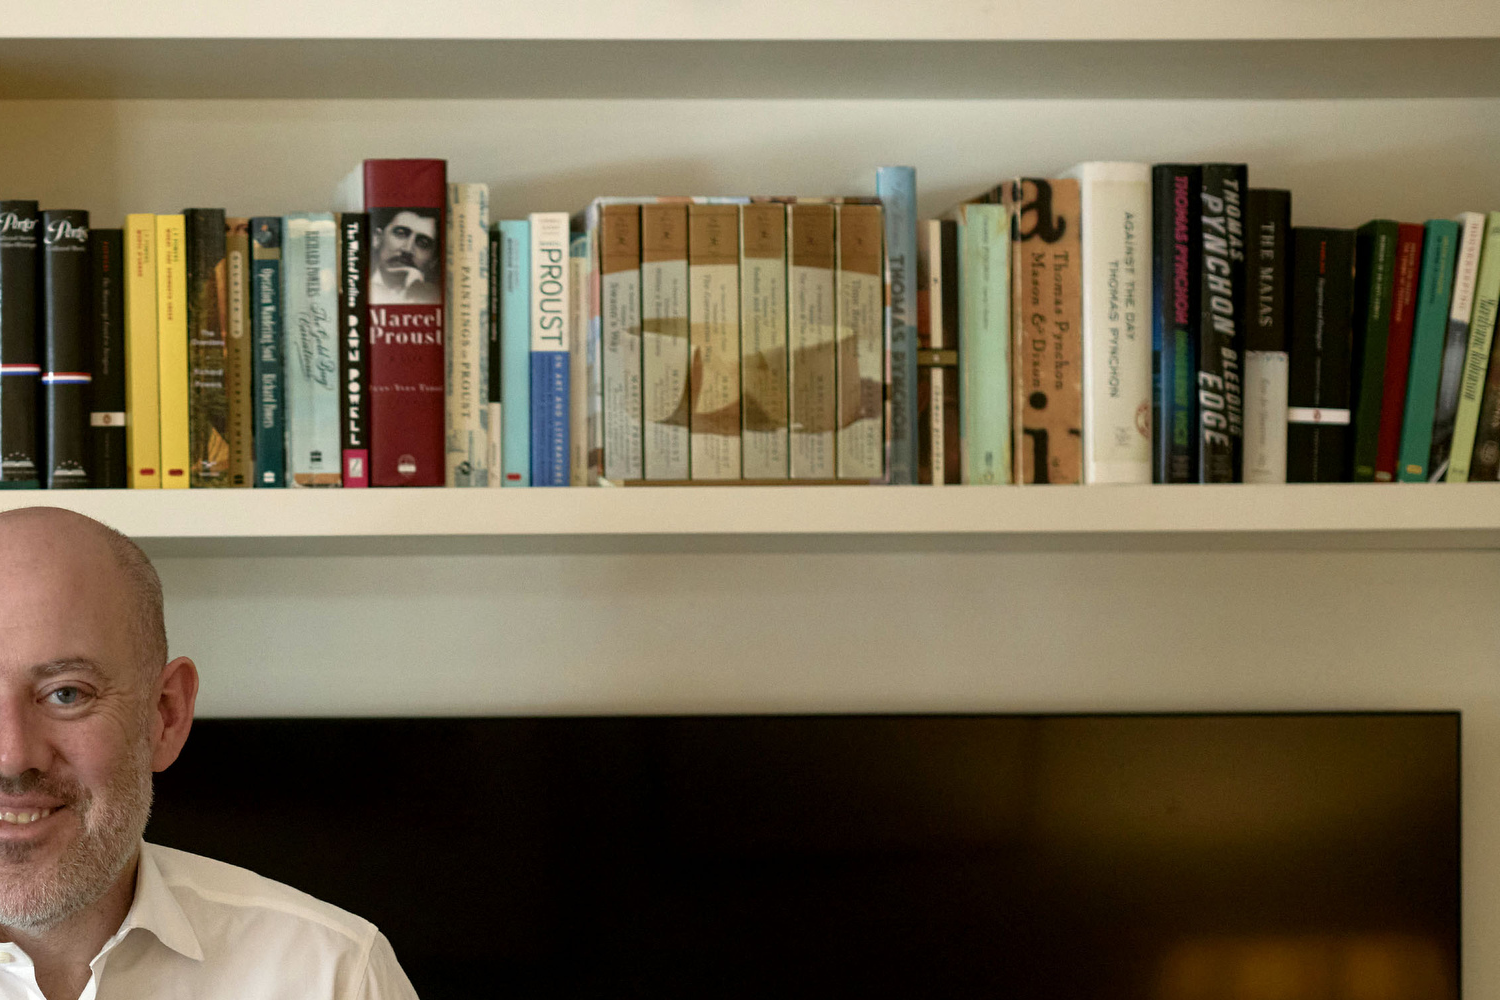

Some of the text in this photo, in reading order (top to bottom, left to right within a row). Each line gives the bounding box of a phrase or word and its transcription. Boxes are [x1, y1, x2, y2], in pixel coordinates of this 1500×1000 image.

[348, 222, 358, 239] The
[1201, 193, 1235, 338] PYNCHON
[1224, 179, 1242, 262] THOMAS
[370, 308, 442, 327] Marcel
[540, 248, 563, 346] PROUST
[1032, 252, 1046, 305] Mason
[1125, 212, 1135, 341] AGAINST THE DAY
[1260, 222, 1275, 328] THE MAIAS
[370, 328, 442, 345] Proust
[1032, 340, 1046, 389] Dixon
[1053, 252, 1071, 390] Thomas Pynchon
[1109, 261, 1120, 398] THOMAS PYNCHON
[348, 315, 360, 446] DAWN POWELL
[1198, 371, 1228, 447] EDGE
